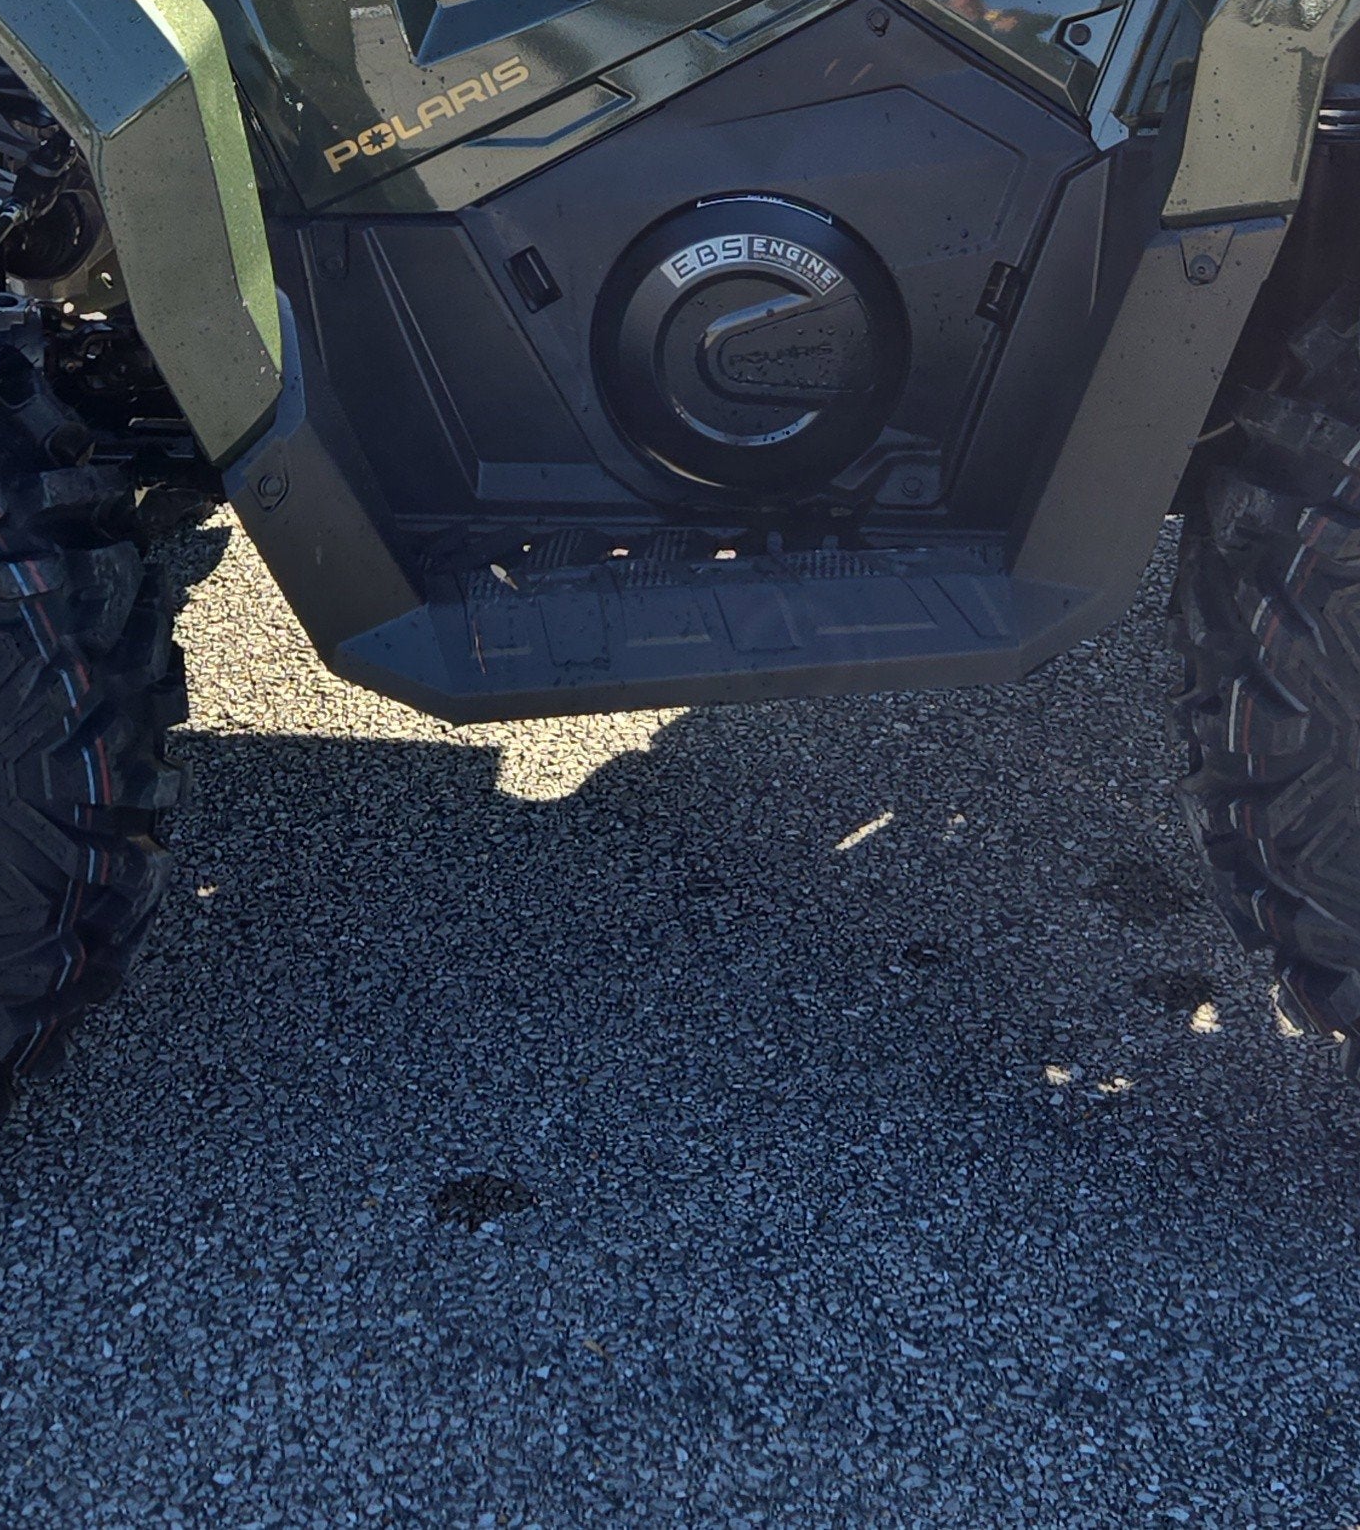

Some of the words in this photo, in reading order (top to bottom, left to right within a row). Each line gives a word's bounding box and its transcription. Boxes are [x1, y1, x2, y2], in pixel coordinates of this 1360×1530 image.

[323, 56, 530, 173] POLARIS
[671, 238, 743, 280] EBS
[753, 239, 838, 285] ENGINE
